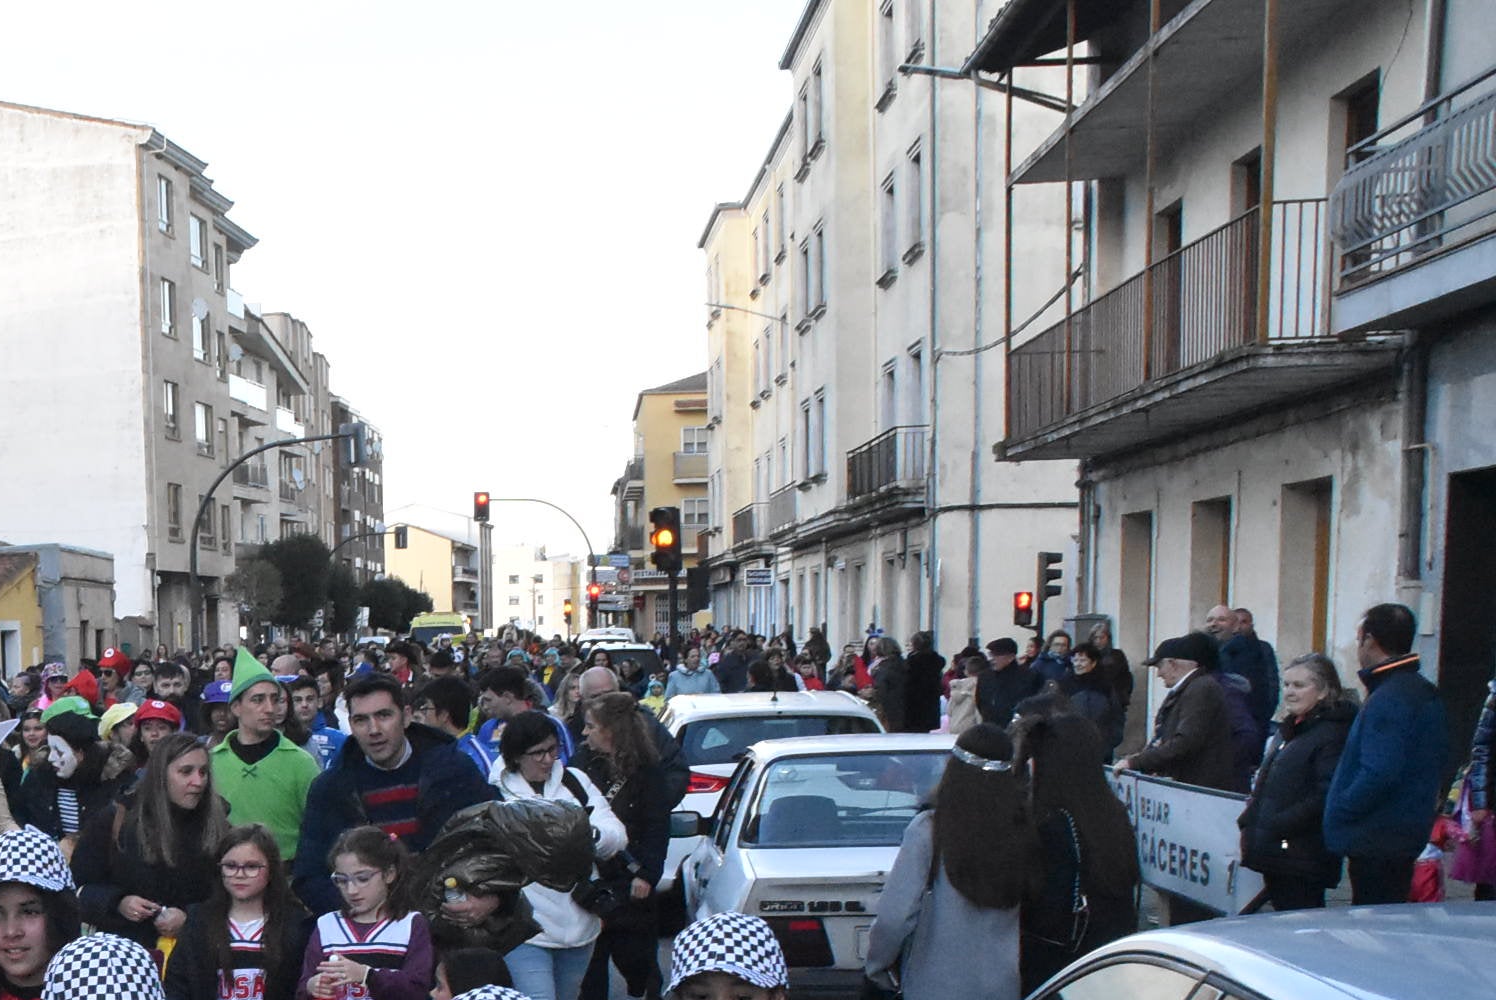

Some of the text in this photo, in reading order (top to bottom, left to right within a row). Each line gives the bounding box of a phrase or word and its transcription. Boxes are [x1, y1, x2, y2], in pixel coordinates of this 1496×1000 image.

[1141, 796, 1170, 825] BEJAR
[1141, 828, 1210, 887] CÁCERES
[219, 975, 266, 1000] USA
